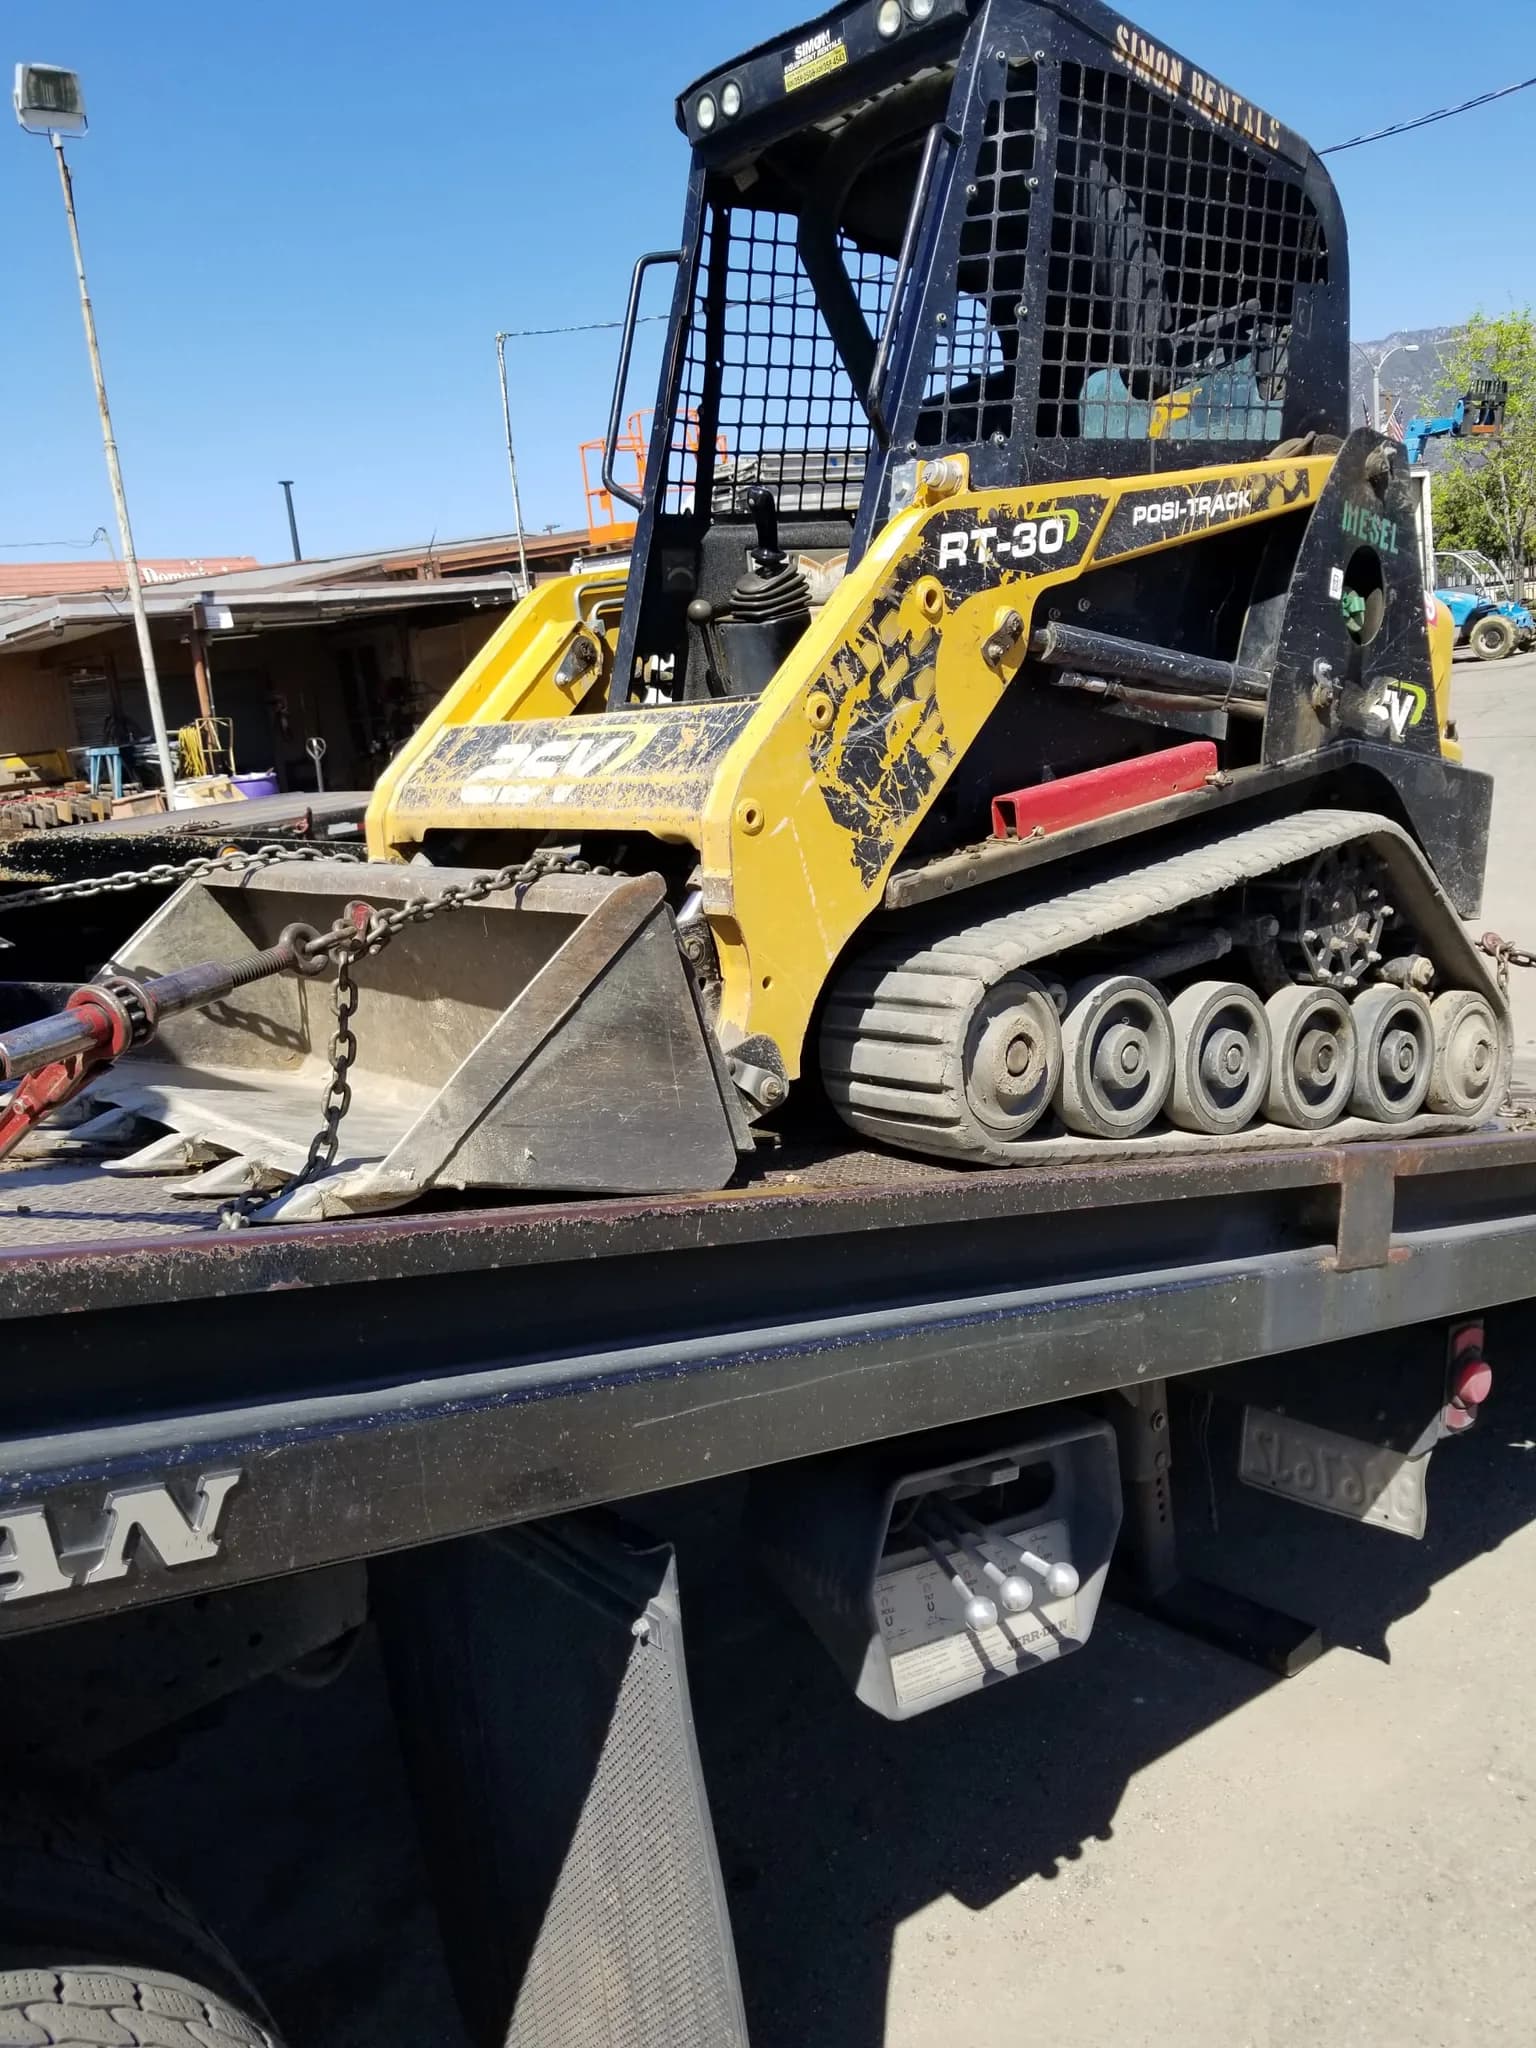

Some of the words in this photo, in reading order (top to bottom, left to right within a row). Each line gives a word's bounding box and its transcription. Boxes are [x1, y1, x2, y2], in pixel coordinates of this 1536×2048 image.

[795, 28, 831, 60] SIMON
[1112, 24, 1183, 97] SIMON
[1187, 71, 1280, 149] RENTALS
[1133, 489, 1252, 526] POSI-TRACK
[1342, 500, 1398, 555] DIESEL
[938, 519, 1064, 570] RT-30
